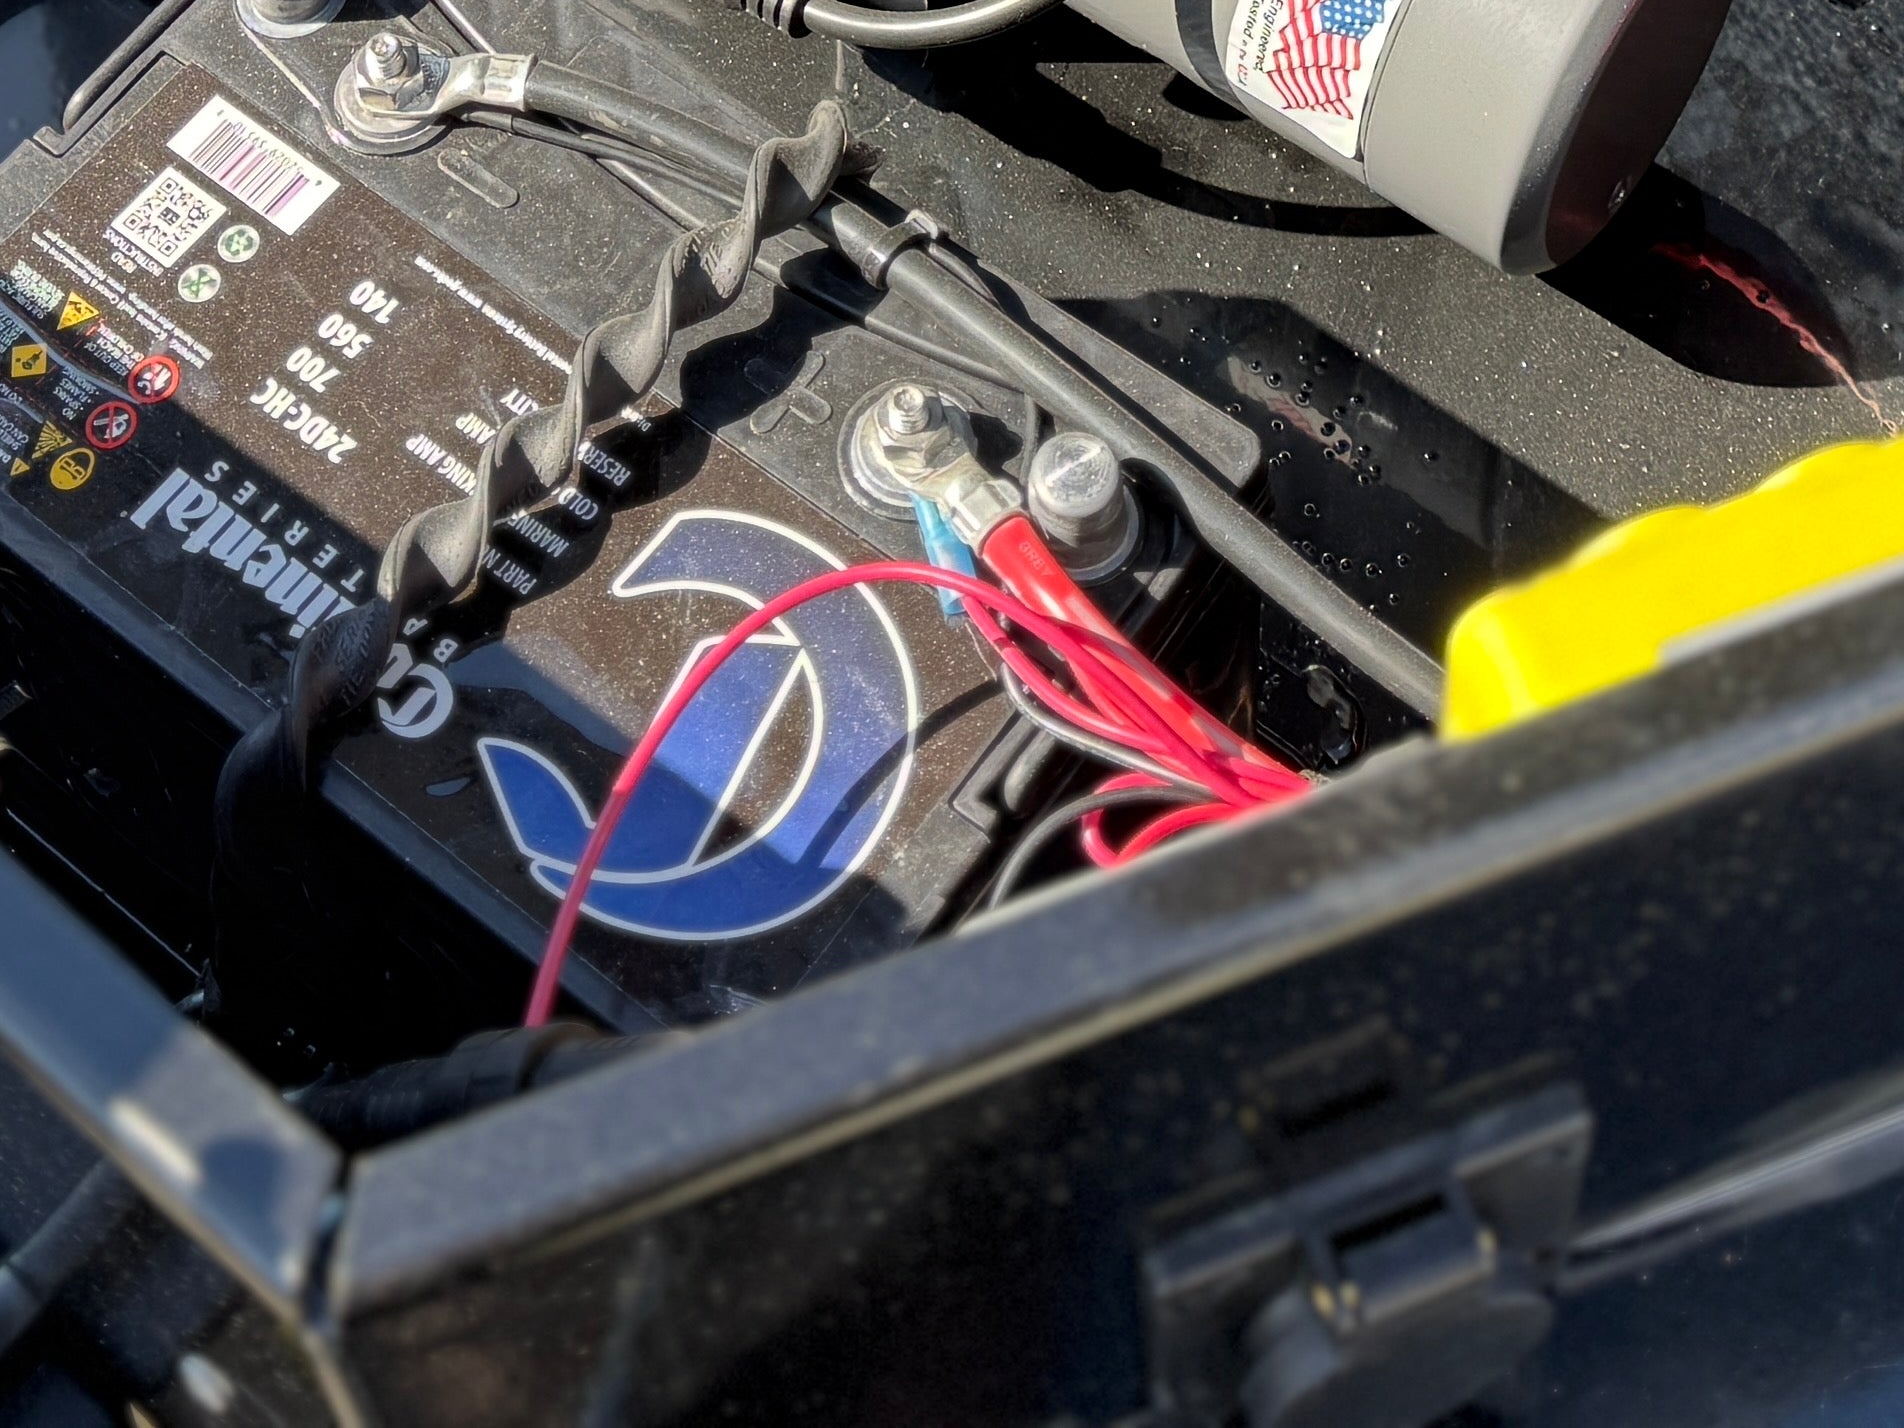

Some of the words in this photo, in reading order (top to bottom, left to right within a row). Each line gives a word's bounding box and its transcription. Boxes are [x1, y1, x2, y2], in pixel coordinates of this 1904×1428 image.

[103, 228, 162, 276] INSTRUCTIONS
[110, 250, 137, 273] READ
[347, 275, 400, 325] 140
[316, 309, 372, 361] 560
[94, 348, 111, 363] OUT
[107, 358, 128, 376] KEEP
[119, 354, 135, 369] THE
[284, 342, 339, 394] 700
[60, 405, 76, 420] NO
[251, 376, 356, 464] 24DC-HC
[454, 408, 495, 446] AMP
[404, 429, 446, 468] AMP
[558, 484, 599, 522] COLD
[205, 461, 456, 663] BATERIES
[493, 556, 536, 595] PART
